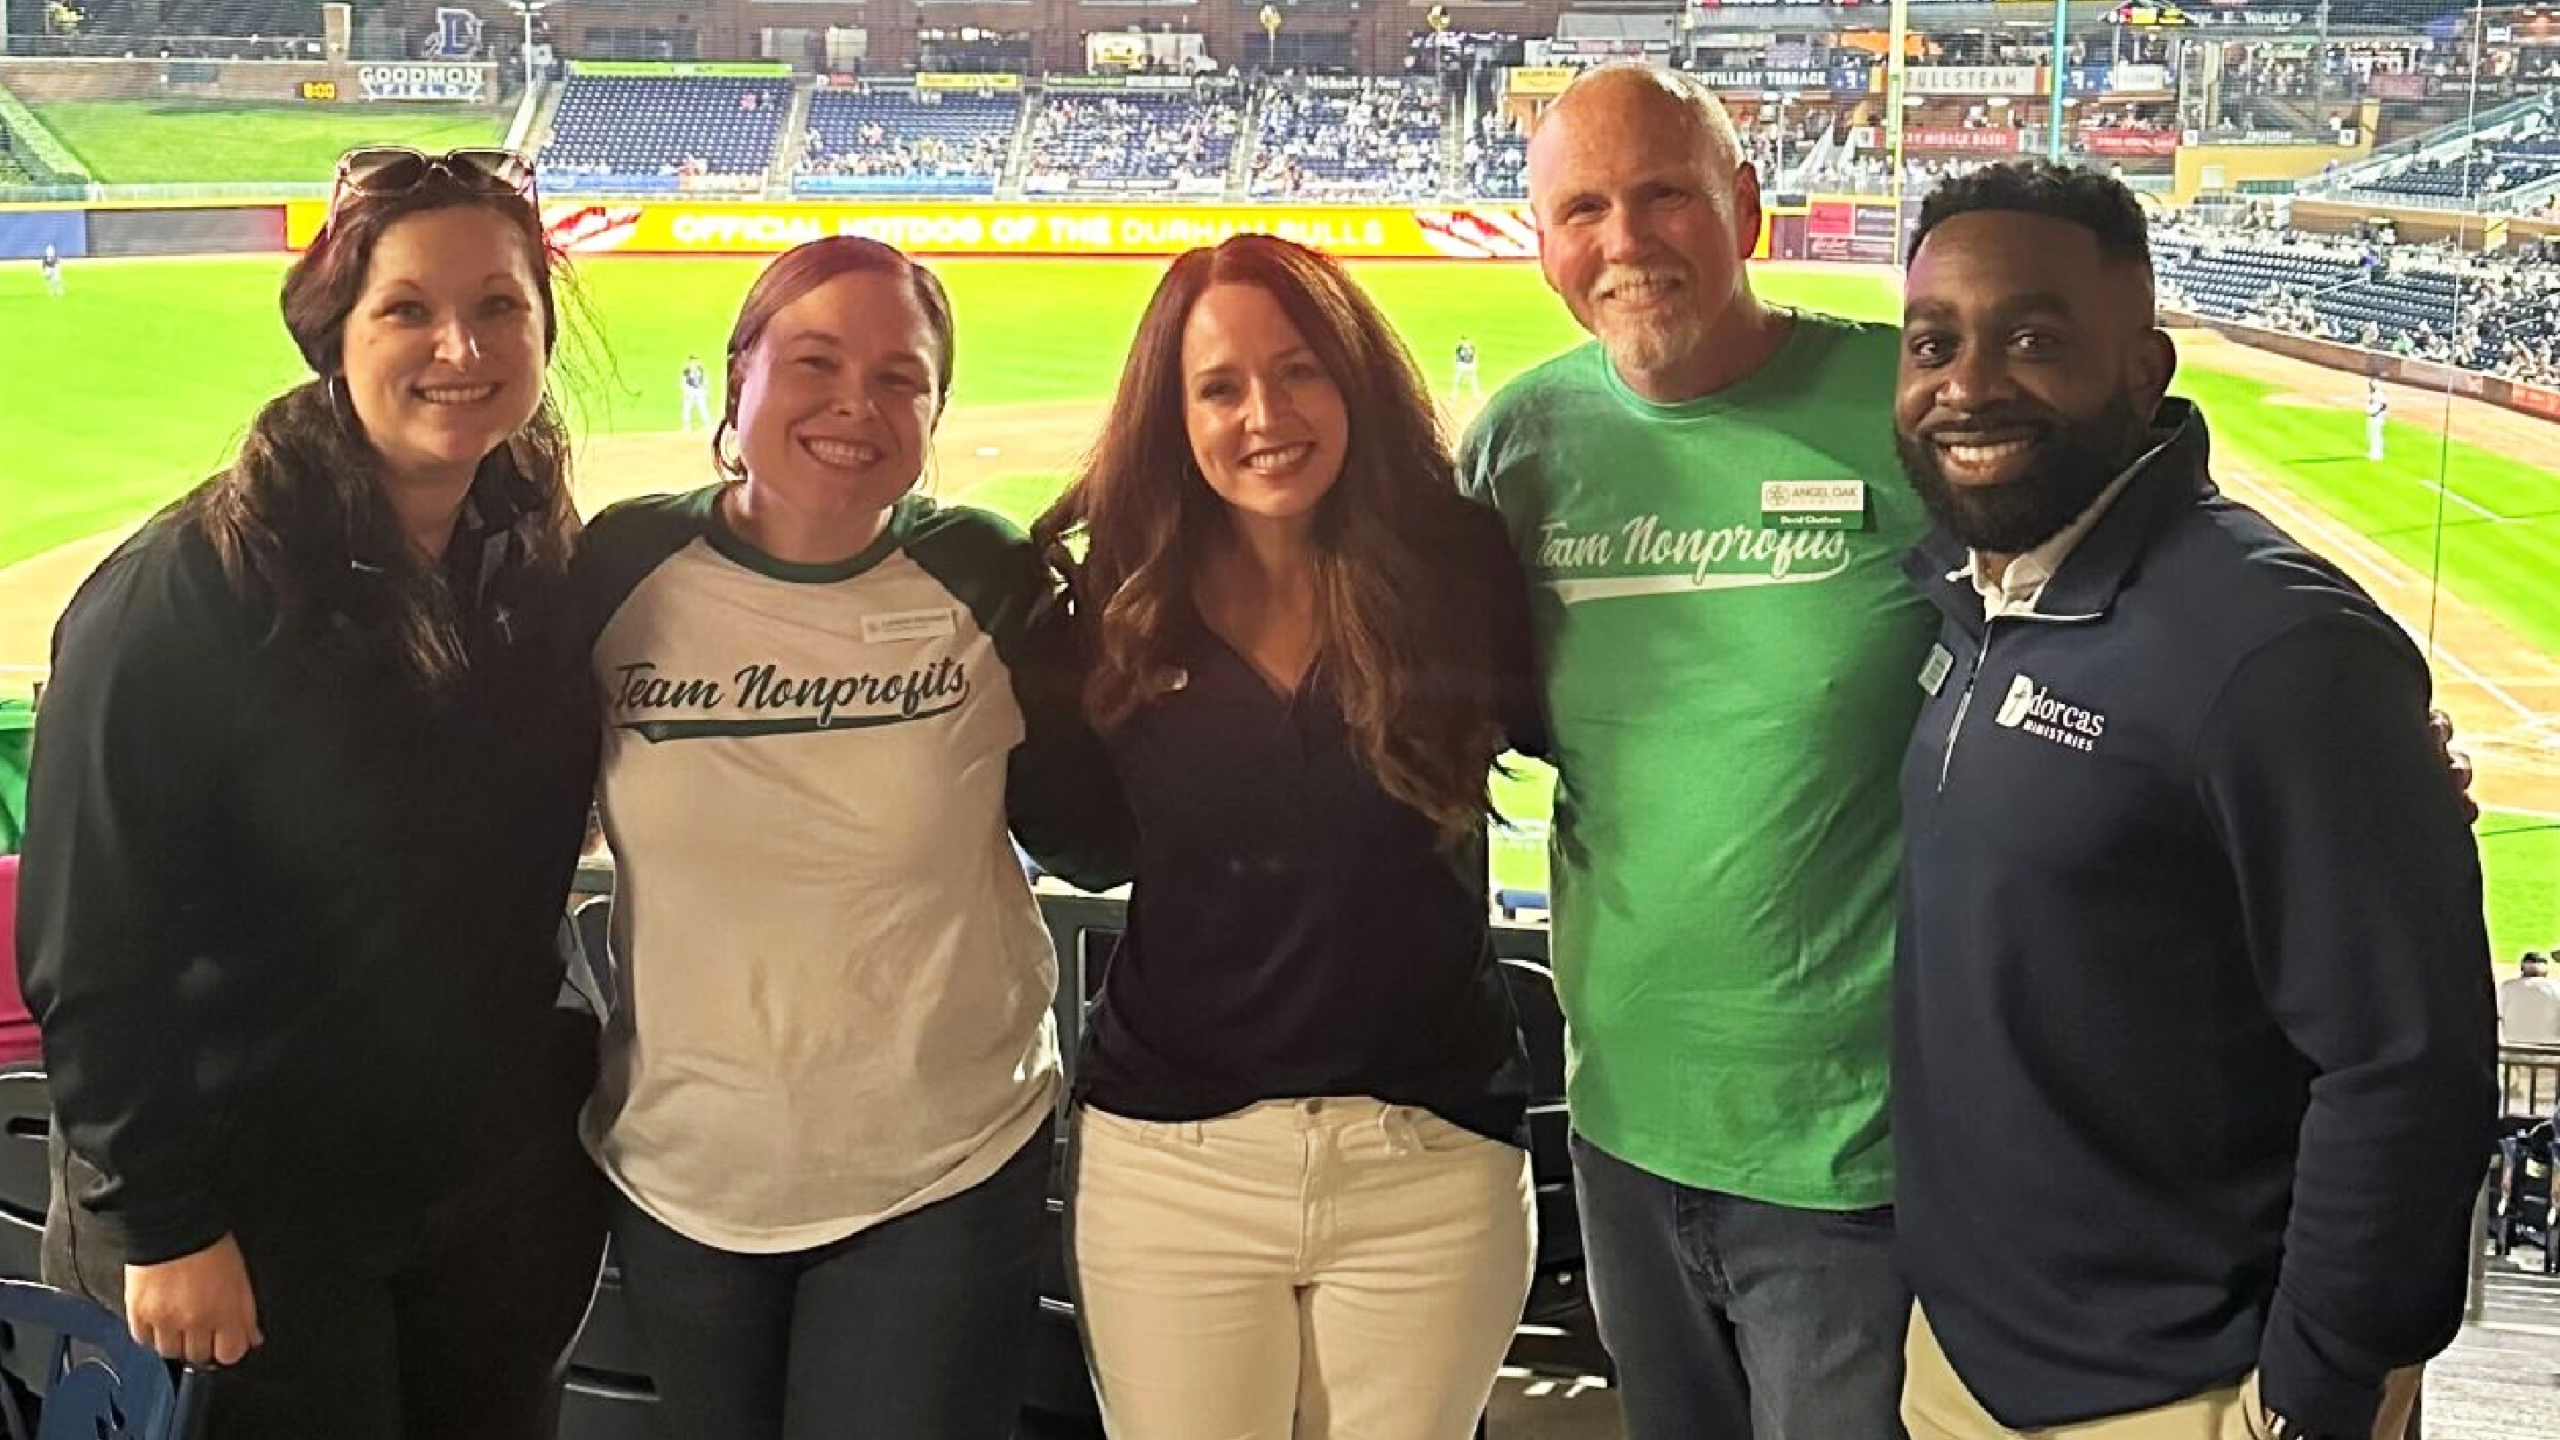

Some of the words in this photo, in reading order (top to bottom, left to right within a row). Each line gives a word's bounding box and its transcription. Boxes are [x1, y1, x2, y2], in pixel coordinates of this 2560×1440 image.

[360, 67, 482, 83] GOODMON
[1765, 71, 1826, 85] TERRACE
[672, 215, 821, 244] OFFICIAL
[990, 215, 1038, 244] OF
[1047, 216, 1111, 244] THE
[1277, 216, 1385, 246] BULLS
[1535, 521, 1613, 568] Team
[613, 661, 726, 710] Team
[734, 655, 965, 727] Nonprofits
[2028, 686, 2105, 737] dorcas
[2023, 719, 2094, 751] MINISTRIES
